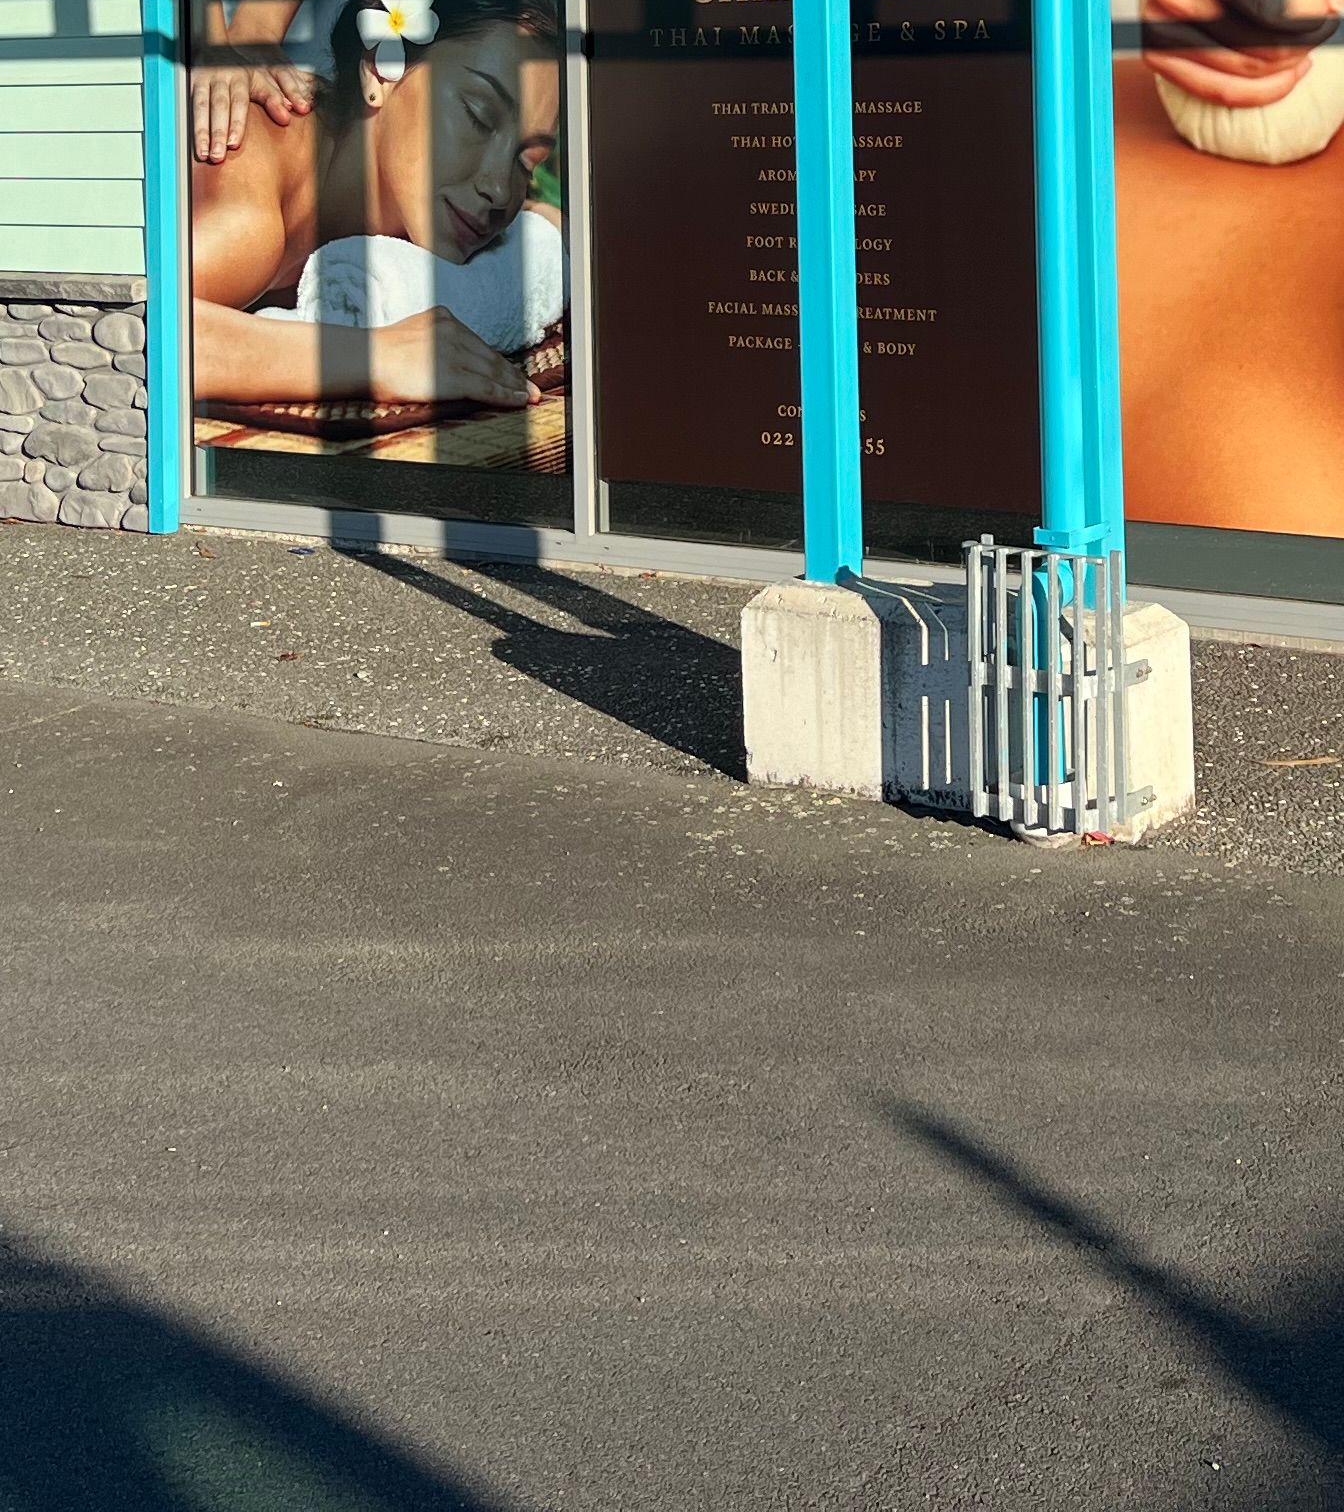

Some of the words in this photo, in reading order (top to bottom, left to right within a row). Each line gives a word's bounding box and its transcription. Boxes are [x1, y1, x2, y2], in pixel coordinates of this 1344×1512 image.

[649, 26, 722, 48] THAI
[900, 20, 915, 42] &
[934, 19, 992, 41] SPA
[712, 103, 747, 115] THAI
[855, 101, 923, 114] MASSAGE
[731, 136, 766, 148] THAI
[771, 136, 796, 148] HO
[750, 203, 797, 215] SWEDI
[746, 236, 784, 249] FOOT
[749, 270, 786, 282] BACK
[708, 301, 757, 315] FACIAL
[762, 303, 799, 316] MASS
[856, 307, 937, 322] REATMENT
[728, 336, 792, 350] PACKAGE
[862, 341, 872, 354] &
[877, 342, 916, 356] BODY
[761, 431, 794, 446] 022
